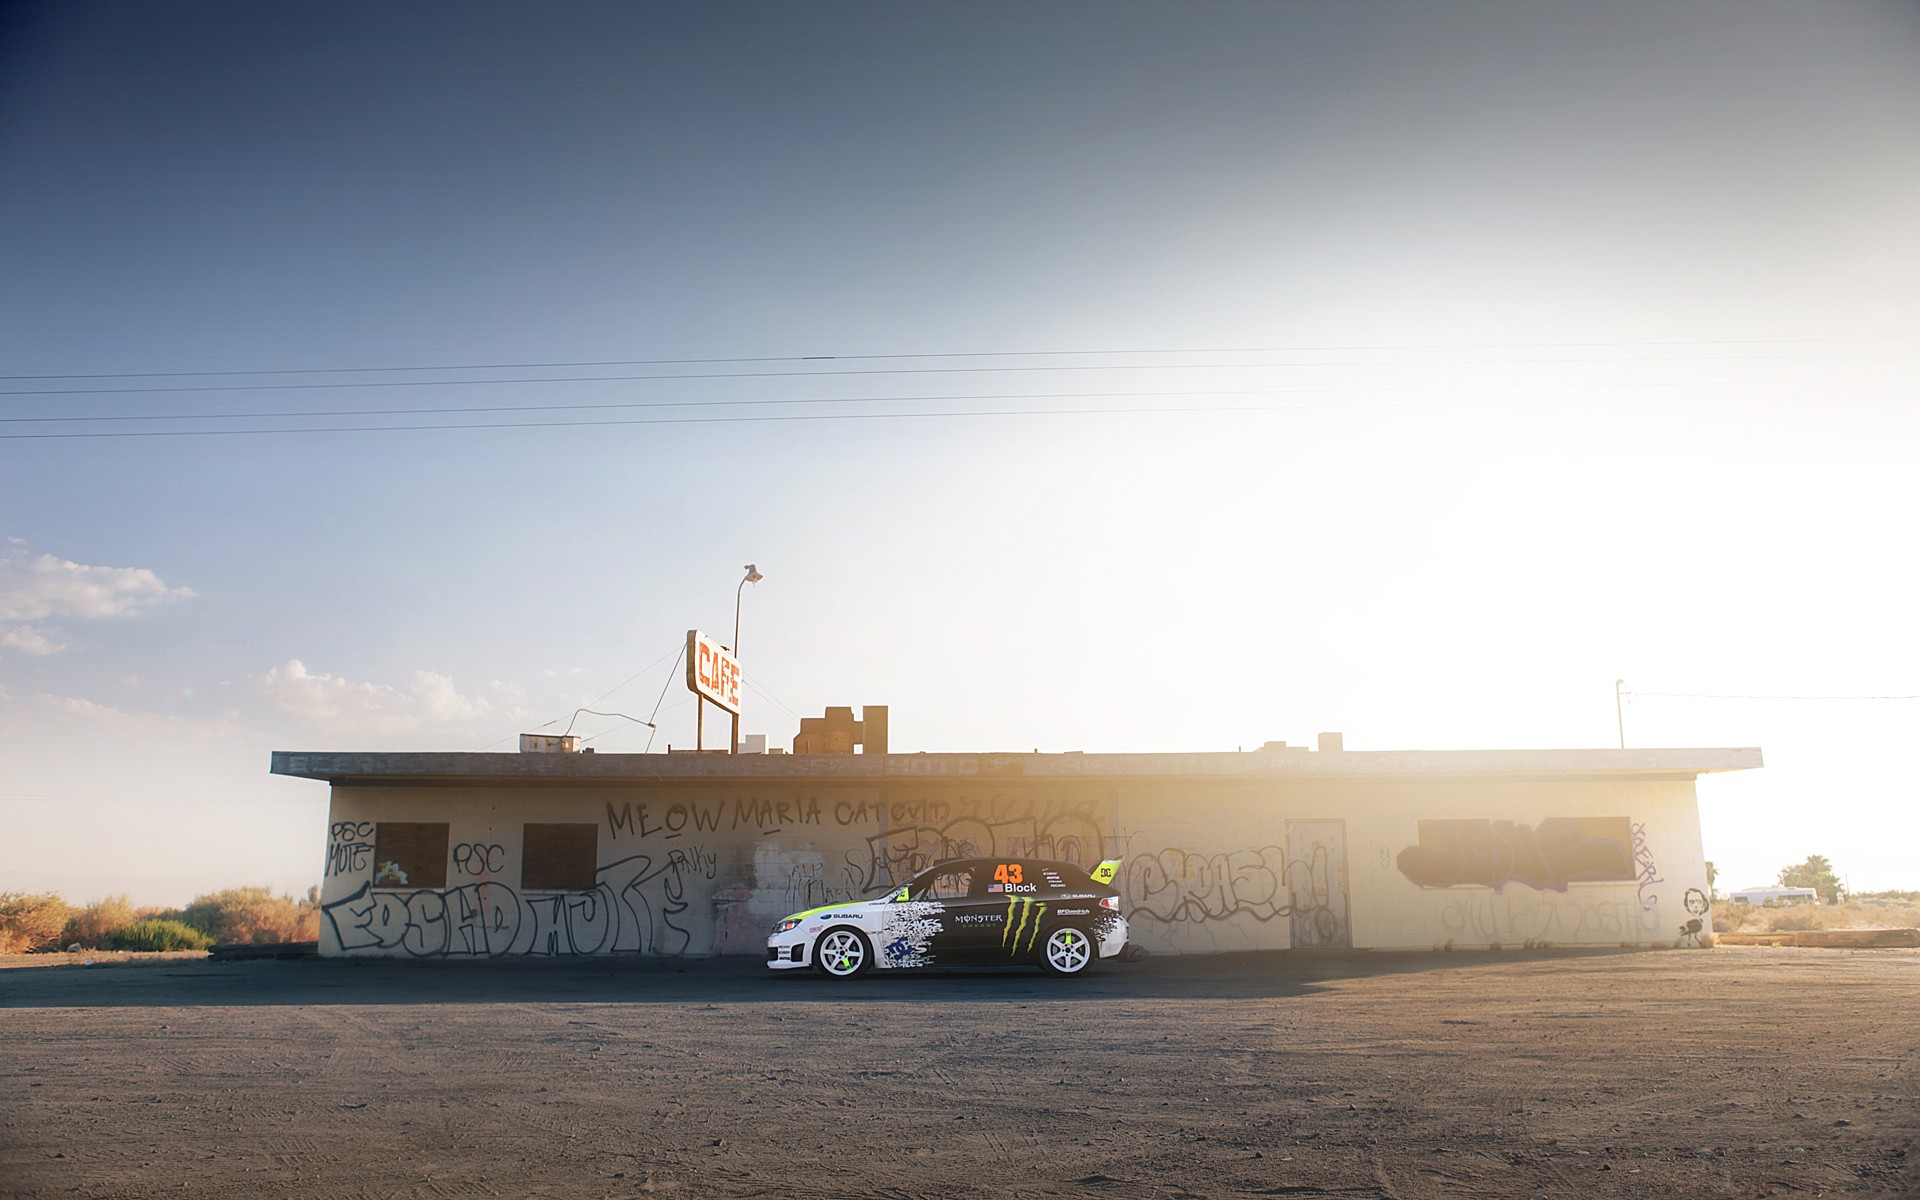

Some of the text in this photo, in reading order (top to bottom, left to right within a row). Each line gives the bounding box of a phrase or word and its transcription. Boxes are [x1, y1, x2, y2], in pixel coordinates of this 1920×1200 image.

[700, 641, 740, 707] CAFE
[607, 803, 724, 839] MEOW
[732, 799, 821, 835] MARIA
[834, 800, 886, 826] CAT
[453, 843, 505, 876] PSC
[994, 864, 1023, 884] 43
[1004, 883, 1037, 893] Block
[955, 914, 1003, 923] MONSTER
